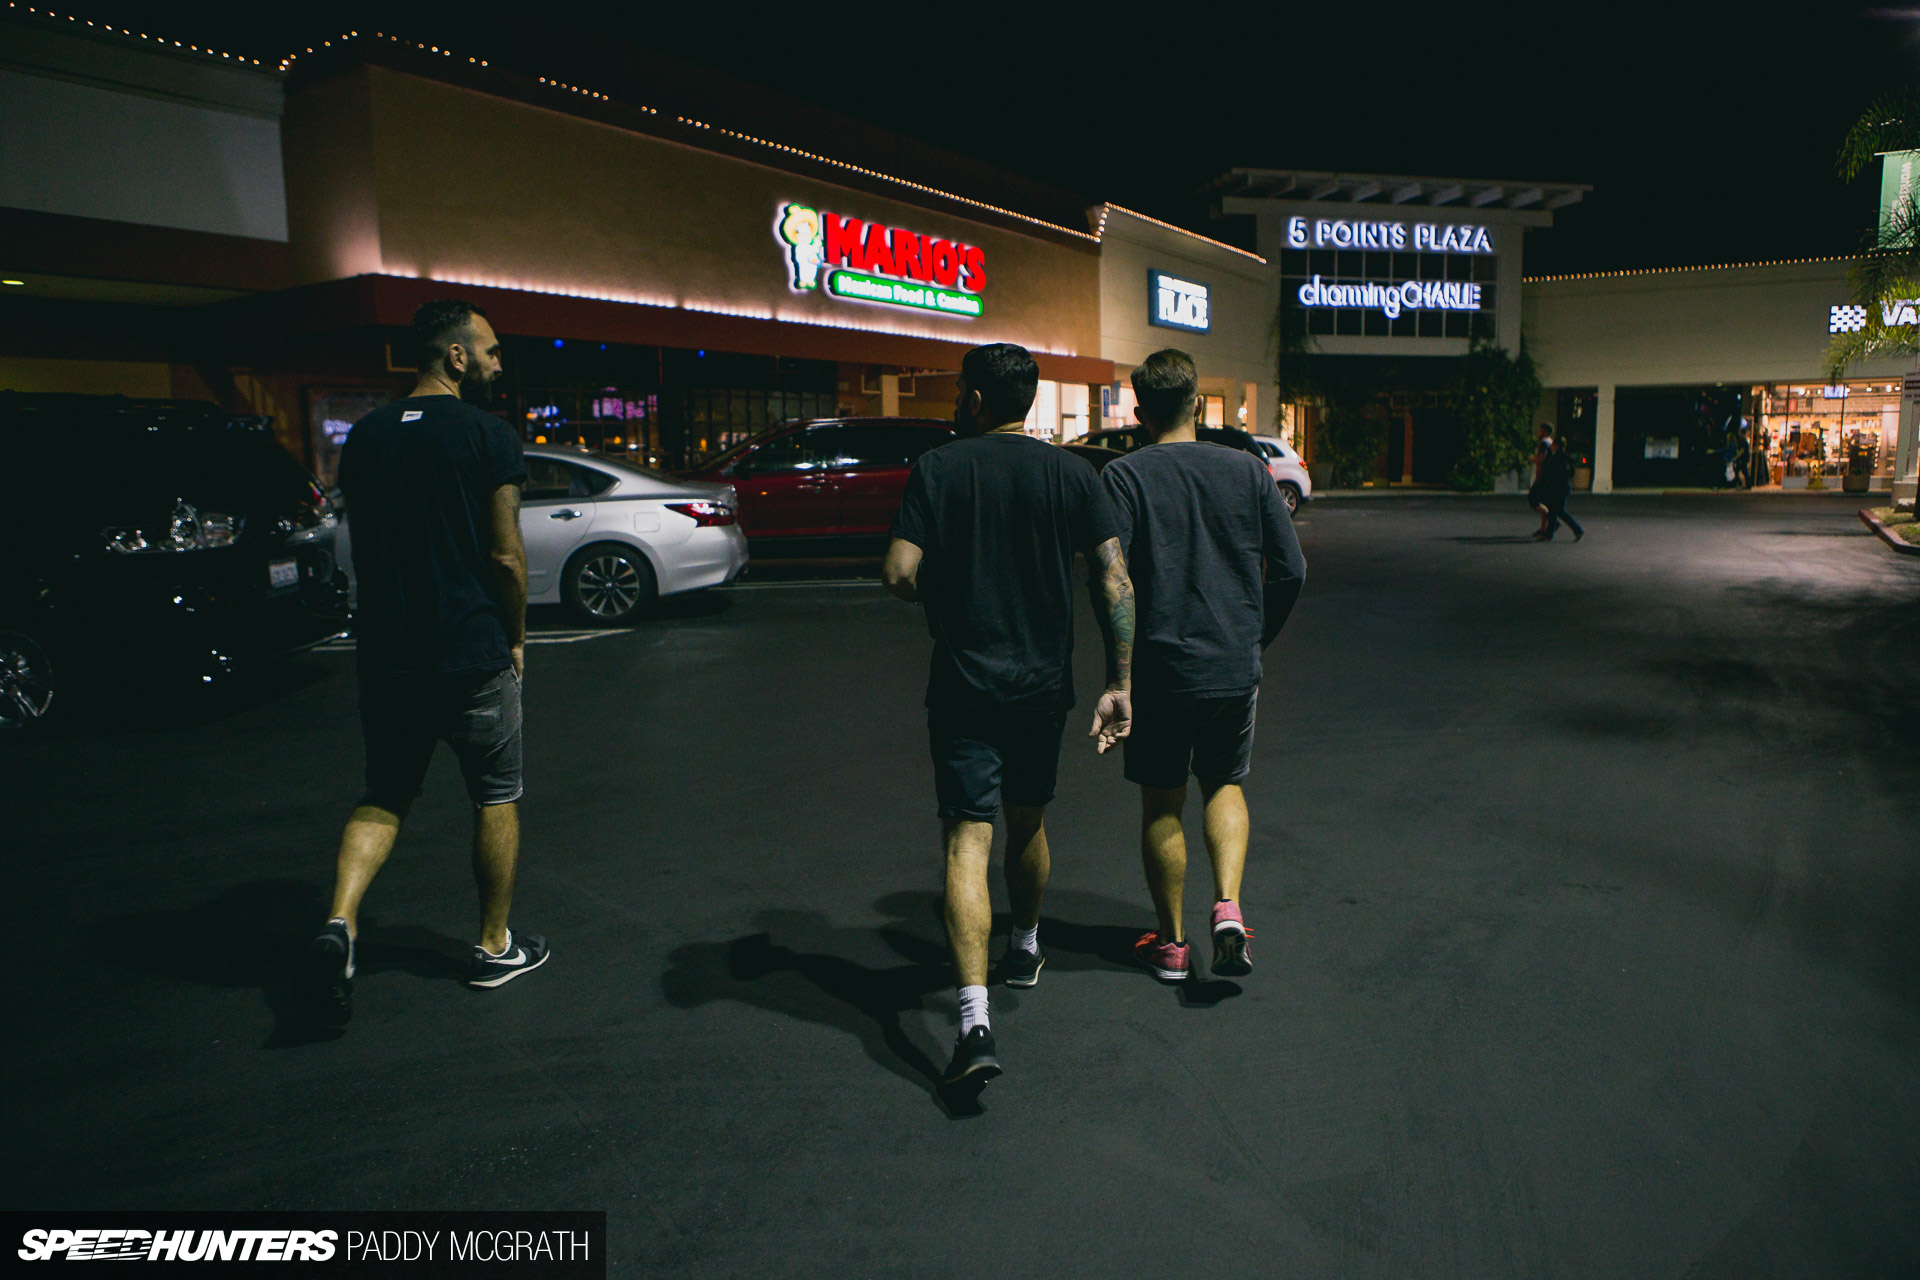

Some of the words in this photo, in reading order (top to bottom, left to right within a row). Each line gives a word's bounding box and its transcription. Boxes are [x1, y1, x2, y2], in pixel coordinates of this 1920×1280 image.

[826, 212, 986, 292] MARIO'S
[1289, 216, 1307, 248] 5
[1315, 219, 1407, 249] POINTS
[1413, 223, 1492, 253] PLAZA
[893, 285, 924, 304] Food
[925, 290, 936, 306] &
[1158, 288, 1208, 329] PLACE
[1880, 298, 1919, 326] VA
